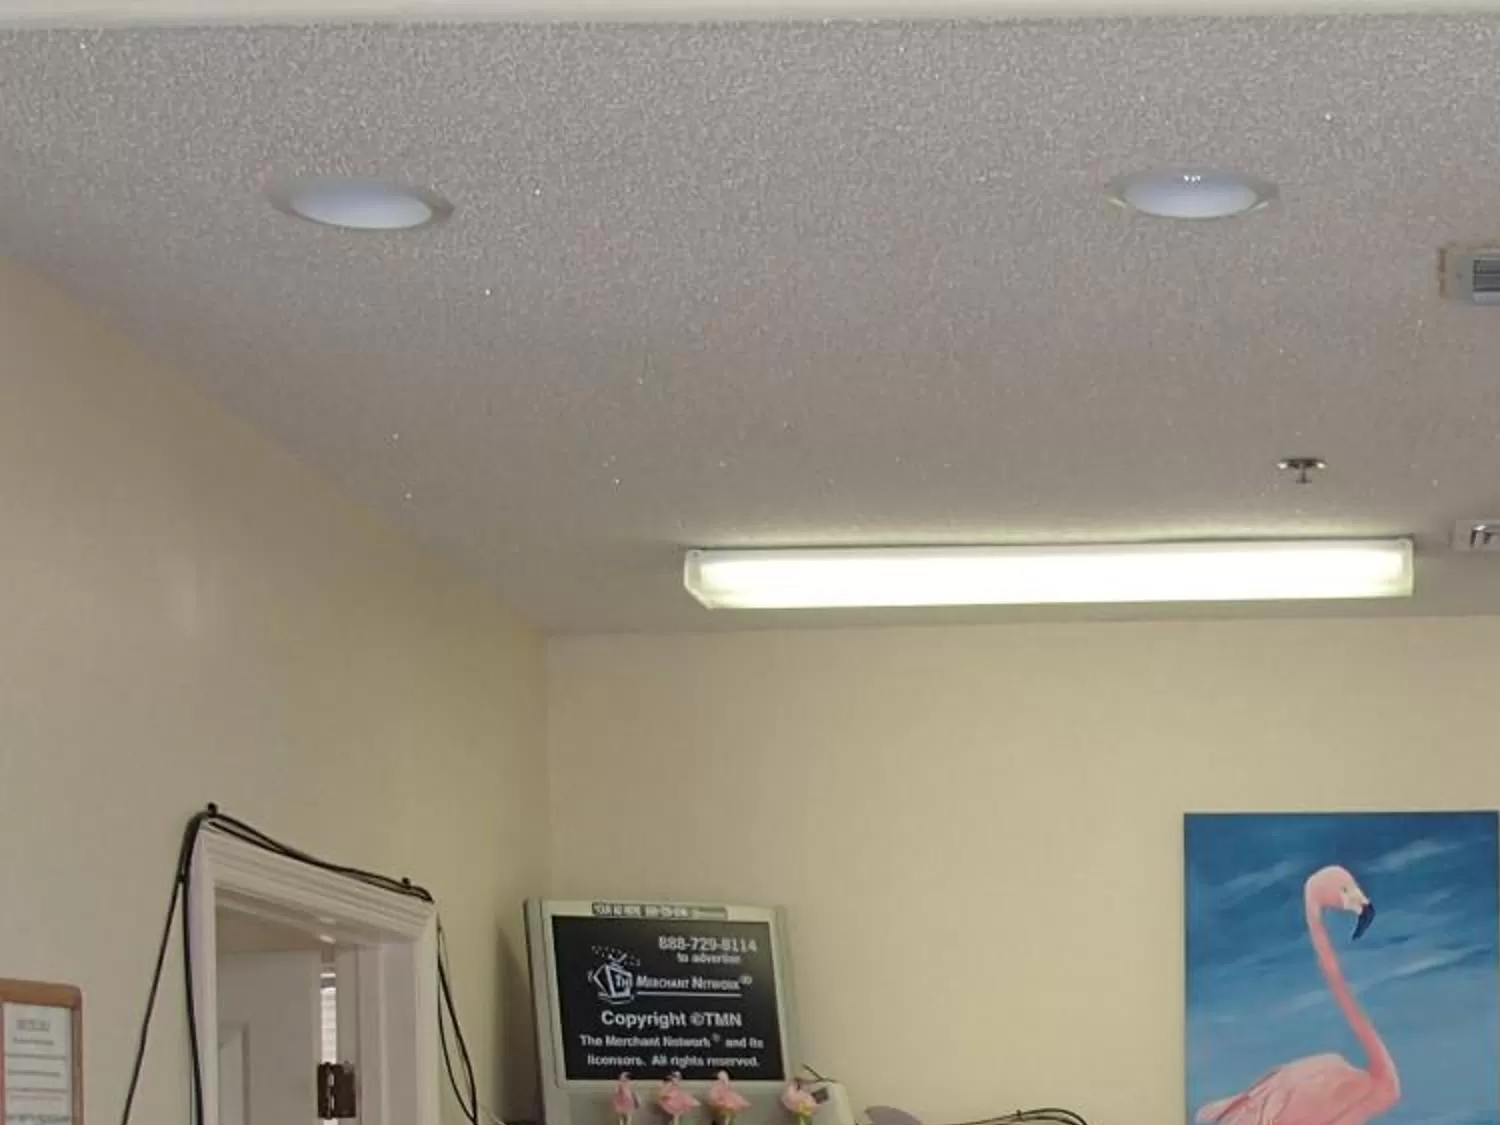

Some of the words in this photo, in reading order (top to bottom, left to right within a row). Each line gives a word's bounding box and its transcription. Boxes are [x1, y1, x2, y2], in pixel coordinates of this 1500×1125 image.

[601, 1010, 687, 1029] Copyright
[579, 1034, 602, 1047] The
[605, 1034, 660, 1048] Merchant
[725, 1037, 747, 1049] and
[651, 1054, 668, 1067] All
[670, 1054, 705, 1070] rights
